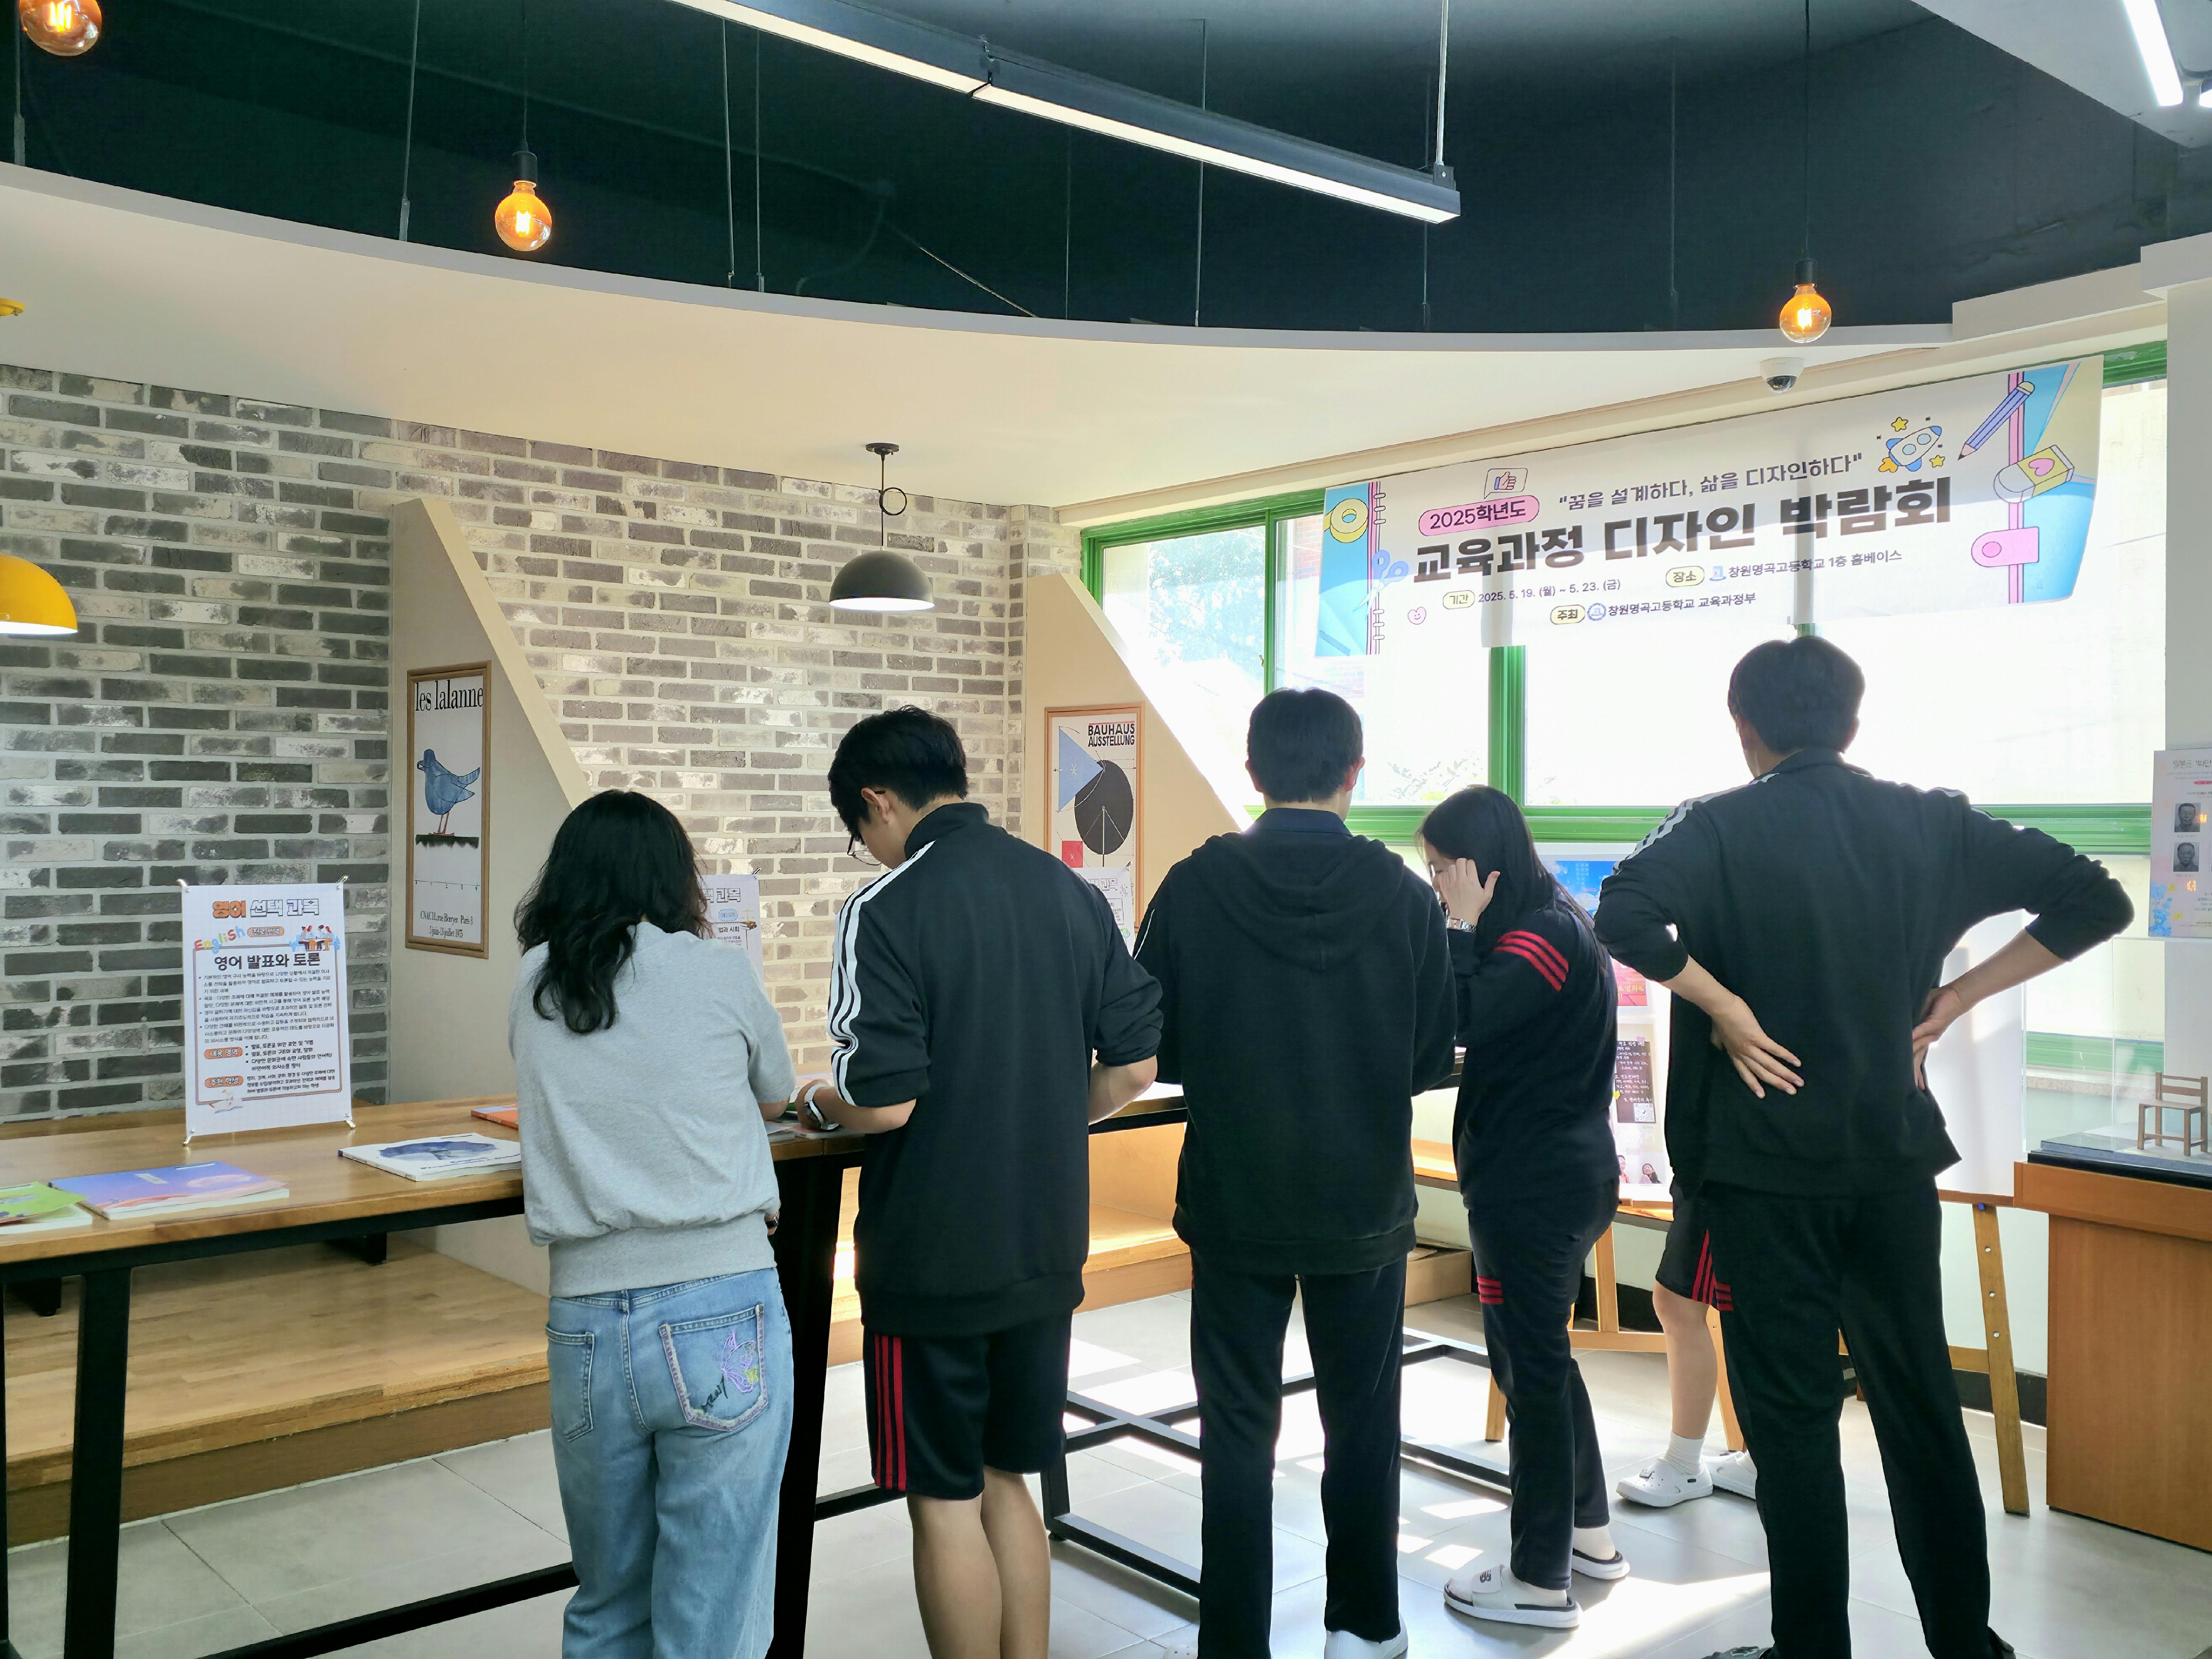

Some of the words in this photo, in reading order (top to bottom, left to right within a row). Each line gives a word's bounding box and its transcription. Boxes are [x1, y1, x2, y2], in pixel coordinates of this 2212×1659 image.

[1559, 491, 1604, 510] "꿈을
[1611, 479, 1693, 505] 설계하다,
[1700, 471, 1738, 493] 삶을
[1746, 453, 1862, 486] 디자인하다"
[1430, 500, 1526, 529] 2025학년도
[1414, 525, 1585, 583] 교육과정
[1605, 503, 1755, 560] 디자인
[1780, 476, 1950, 539] 박람회
[1673, 571, 1697, 582] 장소
[1729, 559, 1824, 578] 창원명곡고등학교
[1829, 556, 1847, 567] 1층
[1851, 550, 1902, 566] 홈베이스
[1450, 594, 1468, 604] 기간
[1479, 592, 1506, 602] 2025.
[1509, 590, 1518, 599] 5.
[1521, 589, 1535, 598] 19.
[1539, 586, 1555, 598] (월)
[1570, 584, 1579, 592] 5.
[1582, 583, 1599, 591] 23.
[1603, 579, 1621, 591] (금)
[1557, 608, 1578, 620] 주최
[1608, 599, 1694, 616] 창원명곡고등학교
[1698, 593, 1756, 608] 교육과정부
[415, 682, 431, 711] les
[435, 679, 483, 710] lalanne
[1088, 724, 1135, 736] BAUHAUS
[1088, 735, 1135, 747] AUSSTELLUNG
[716, 888, 740, 902] 과목
[1101, 878, 1118, 891] 과목
[212, 900, 246, 918] 영어
[250, 900, 283, 917] 선택
[287, 899, 319, 916] 과목
[194, 926, 245, 954] English
[214, 956, 242, 971] 영어
[248, 954, 289, 969] 발표와
[293, 952, 320, 966] 토론
